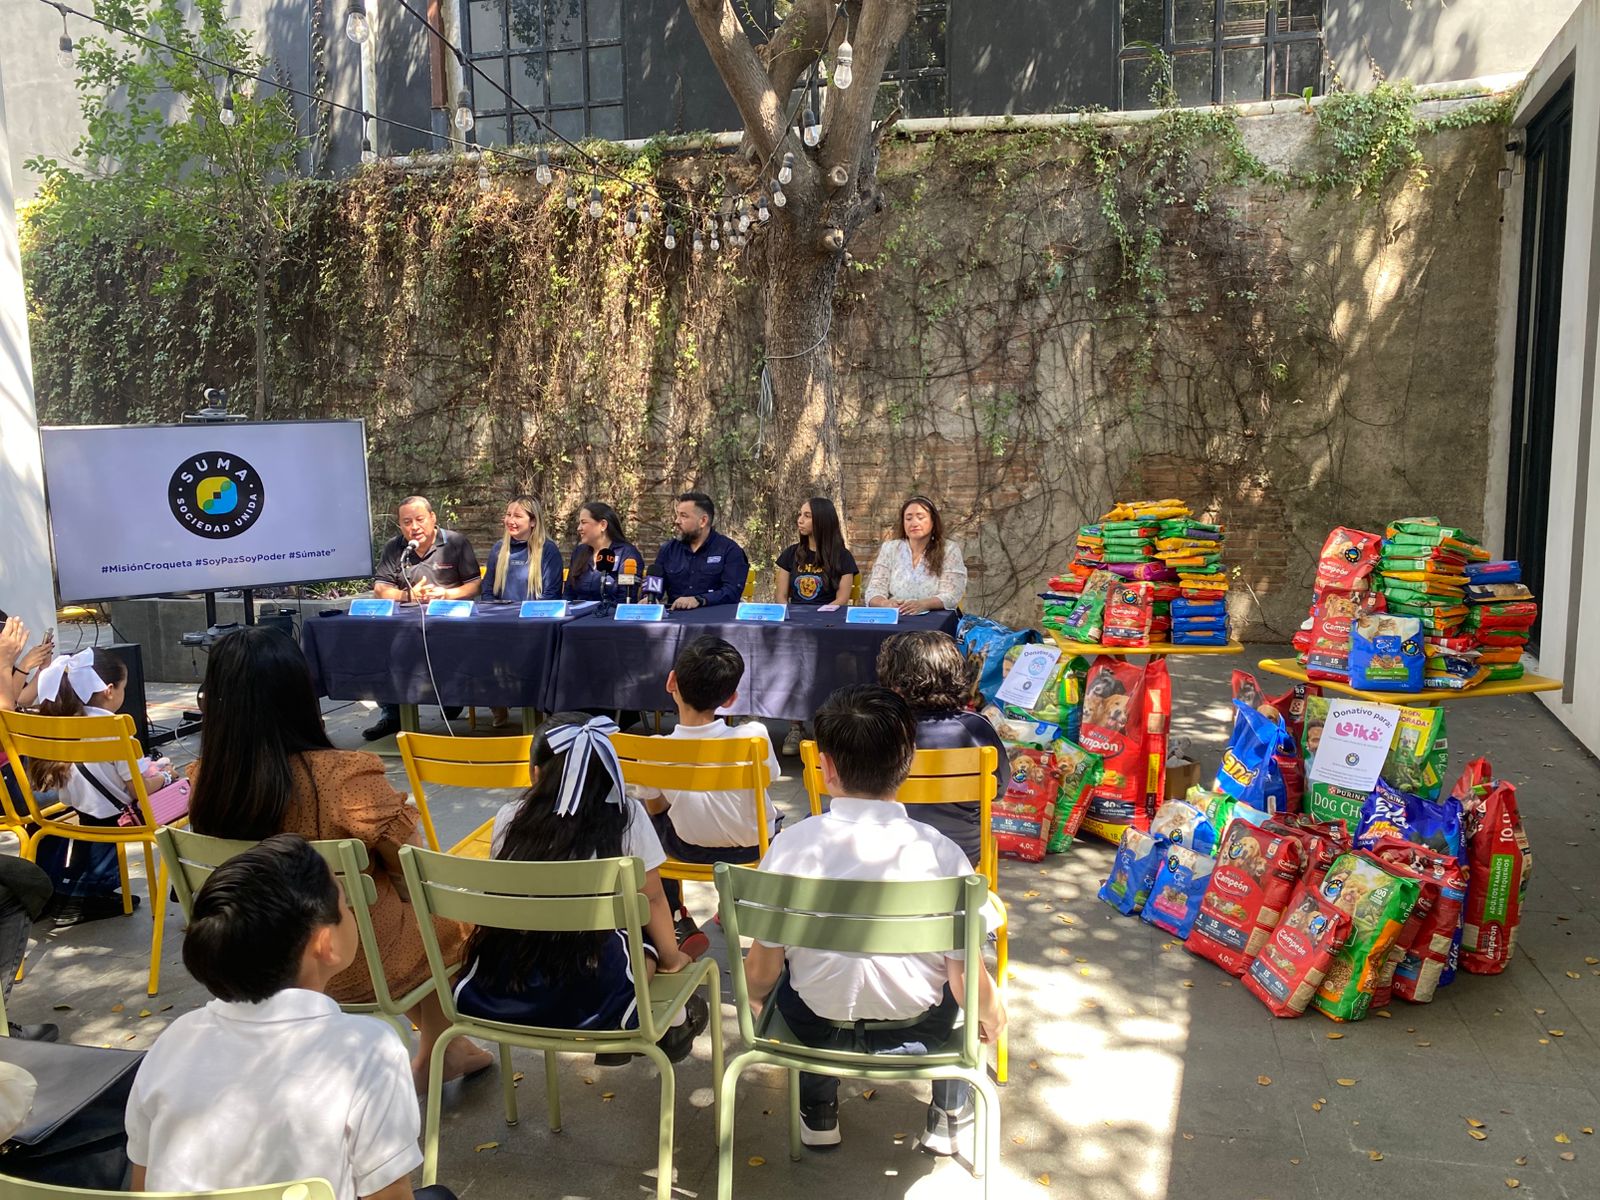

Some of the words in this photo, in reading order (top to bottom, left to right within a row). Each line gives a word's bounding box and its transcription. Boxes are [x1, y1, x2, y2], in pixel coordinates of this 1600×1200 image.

[181, 457, 248, 483] SUMA
[176, 497, 230, 534] SOCIEDAD
[234, 492, 258, 527] UNIDA
[101, 559, 193, 574] #MisiónCroqueta
[195, 551, 287, 568] #SoyPazSoyPoder
[1333, 706, 1373, 719] Donativo
[1373, 712, 1393, 729] para:
[1313, 791, 1337, 812] DOG
[1336, 788, 1366, 801] PURINA
[1215, 870, 1249, 893] Campeón
[1210, 919, 1220, 928] 15
[1278, 928, 1307, 956] Campeón
